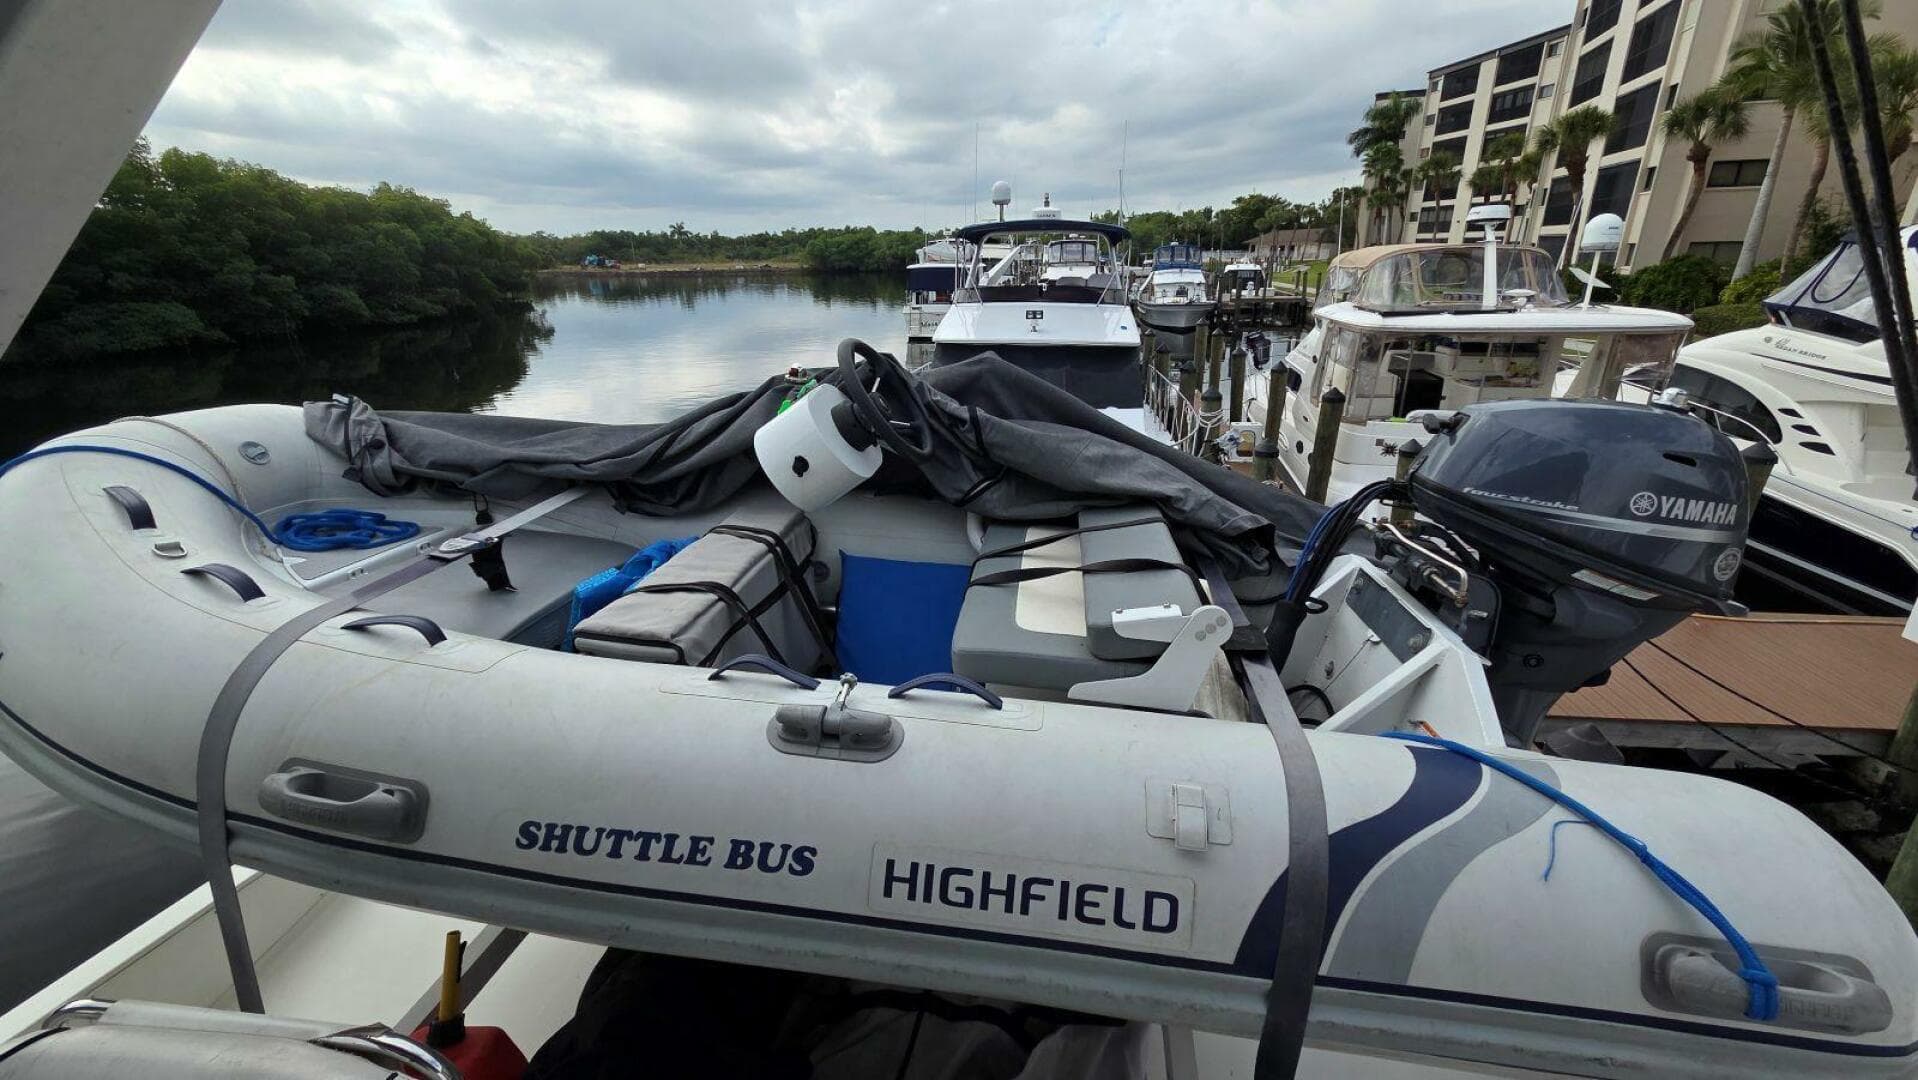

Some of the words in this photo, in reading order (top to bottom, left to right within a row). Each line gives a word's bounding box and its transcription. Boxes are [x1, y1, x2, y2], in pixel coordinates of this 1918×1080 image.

[1660, 495, 1738, 525] YAMAHA
[515, 820, 715, 866] SHUTTLE
[723, 838, 818, 876] BUS
[883, 858, 1179, 934] HIGHFIELD
